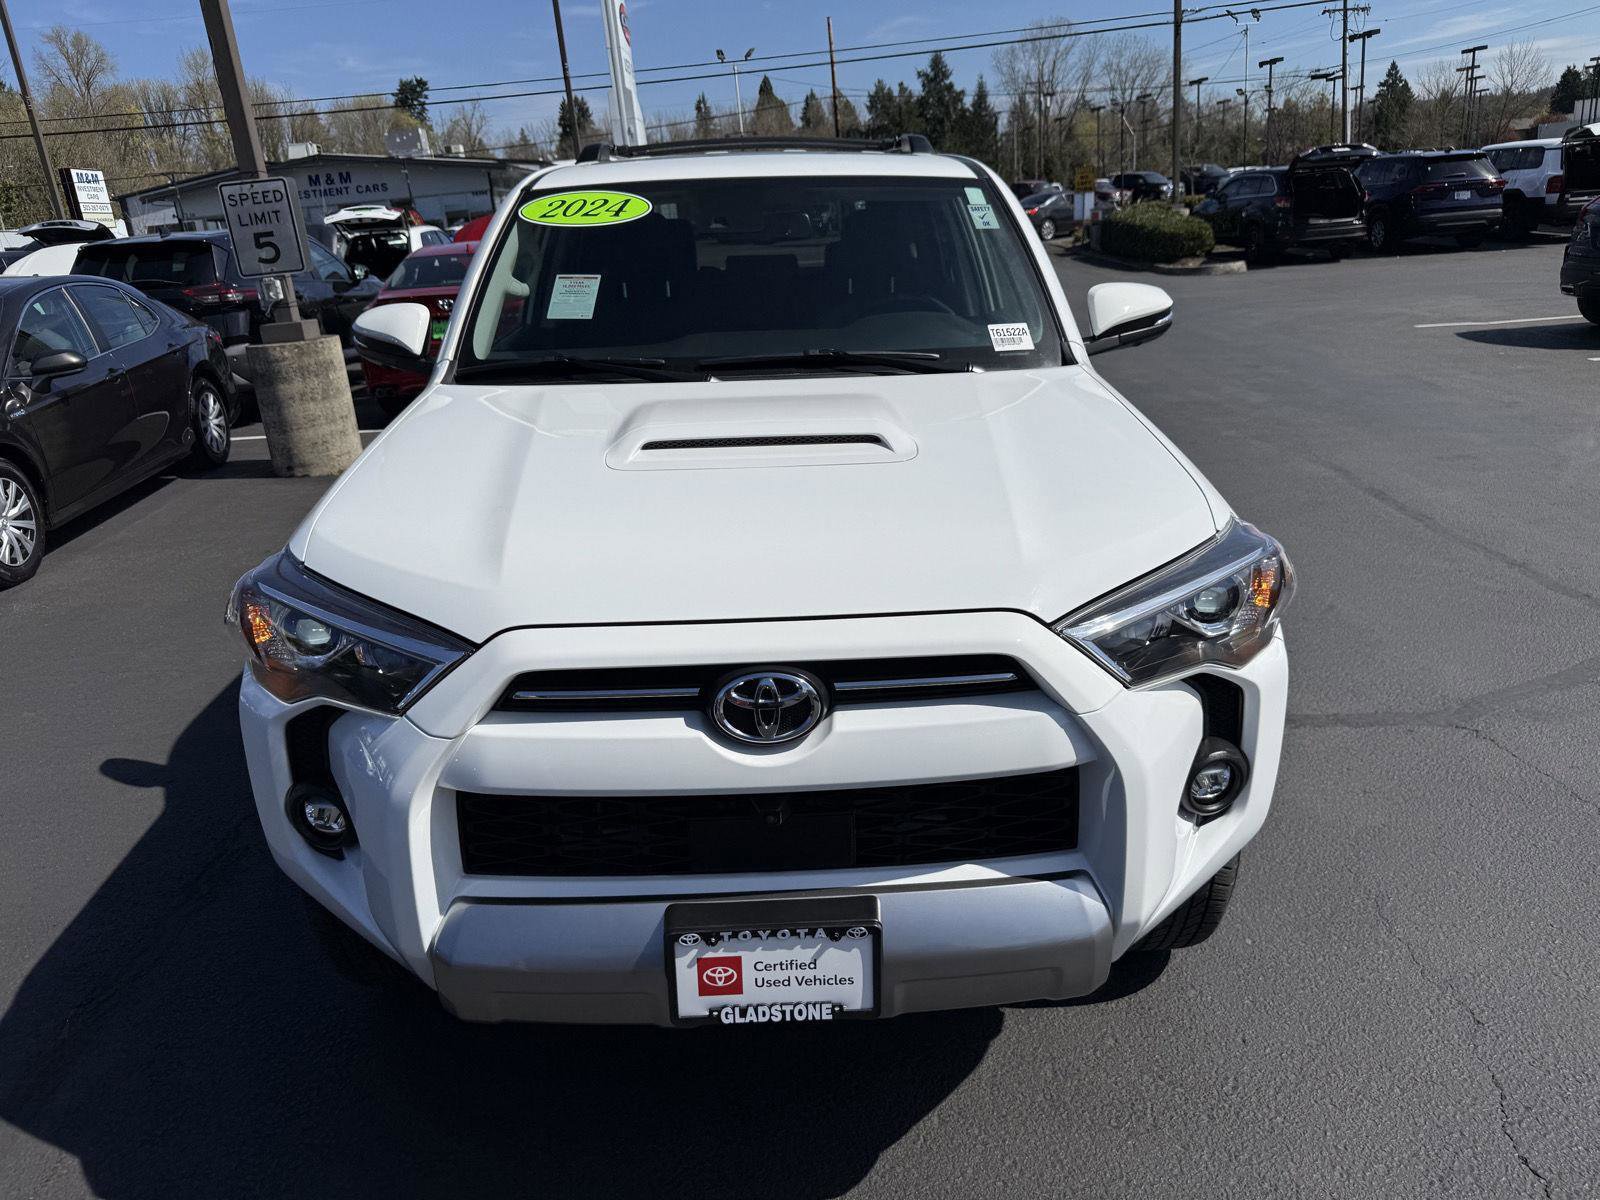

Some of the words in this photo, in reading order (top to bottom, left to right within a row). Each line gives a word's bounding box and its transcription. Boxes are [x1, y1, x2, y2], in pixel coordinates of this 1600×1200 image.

[307, 174, 321, 187] M
[325, 173, 335, 186] &
[338, 171, 352, 184] M
[227, 189, 284, 207] SPEED
[298, 186, 350, 200] ESTMENT
[355, 182, 389, 194] CARS
[538, 198, 632, 218] 2024
[238, 210, 280, 227] LIMIT
[253, 230, 281, 264] 5
[990, 327, 1028, 337] T61522A
[720, 928, 828, 942] TOYOTA
[753, 959, 817, 972] Certified
[754, 976, 791, 988] Used
[794, 974, 855, 987] Vehicles
[720, 1003, 833, 1024] GLADSTONE
